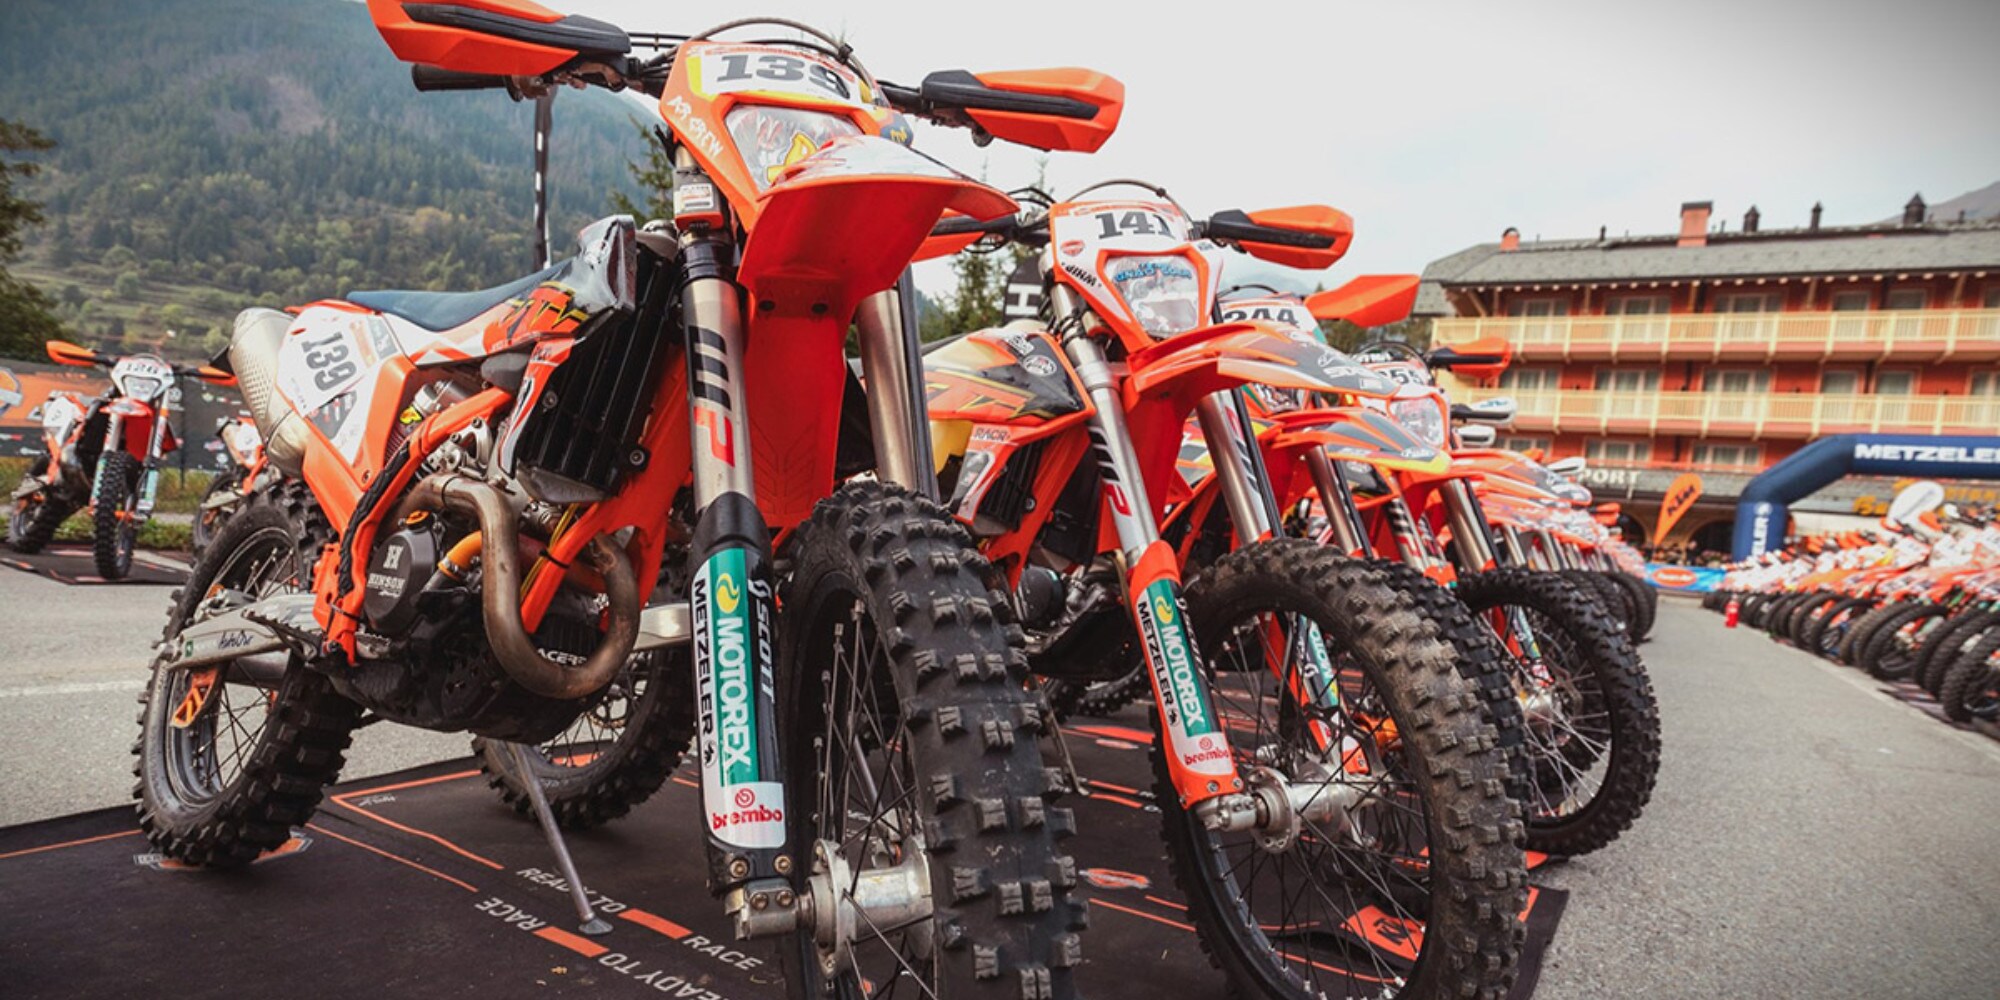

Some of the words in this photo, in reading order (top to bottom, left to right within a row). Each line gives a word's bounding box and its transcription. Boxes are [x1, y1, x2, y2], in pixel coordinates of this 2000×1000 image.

[717, 54, 850, 99] 139
[1095, 211, 1175, 240] 141
[301, 332, 357, 391] 139
[367, 572, 406, 590] HINSON
[694, 578, 714, 735] METZELER
[756, 600, 775, 703] SCOTT
[1137, 601, 1174, 706] METZELER
[716, 616, 752, 772] MOTOREX
[1161, 625, 1204, 728] MOTOREX
[1183, 746, 1229, 766] brembo
[712, 804, 783, 831] brembo
[474, 896, 548, 931] RACE
[590, 895, 627, 913] TO
[682, 935, 763, 970] RACE
[598, 952, 641, 975] TO
[633, 969, 728, 1000] EADY
